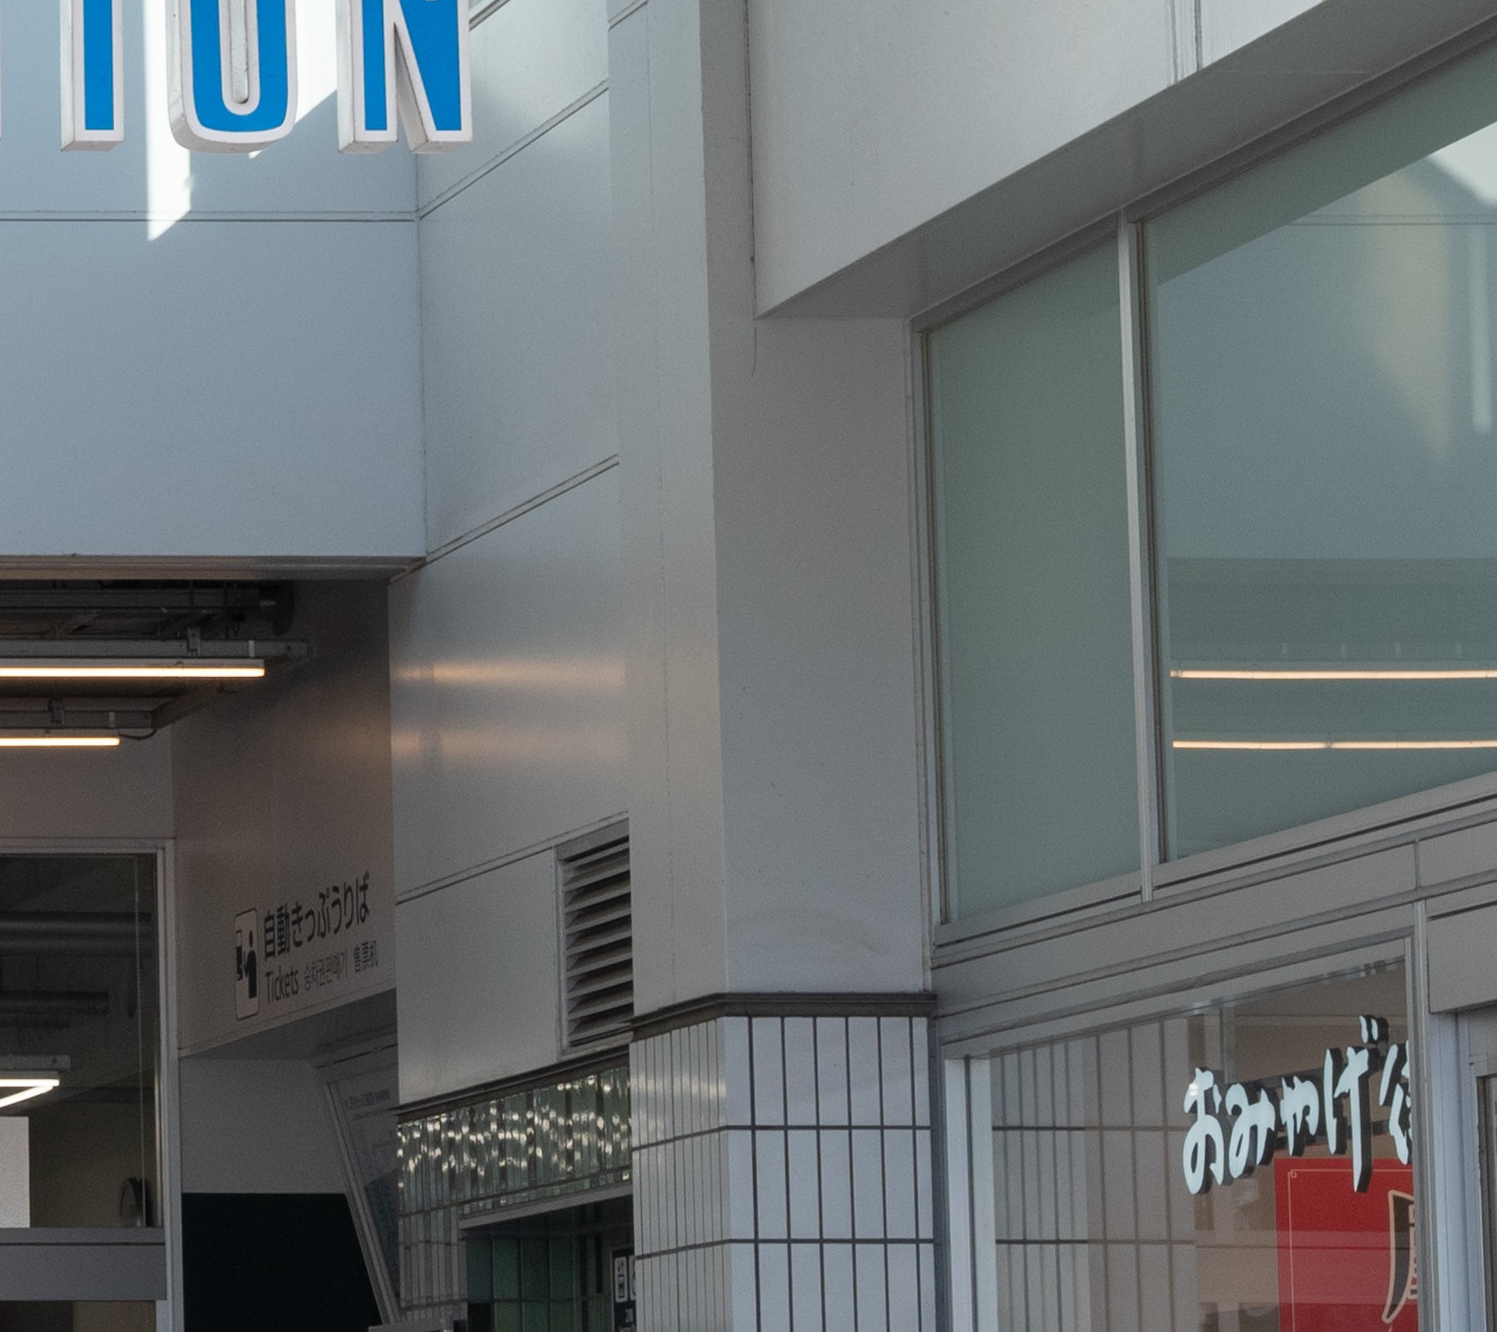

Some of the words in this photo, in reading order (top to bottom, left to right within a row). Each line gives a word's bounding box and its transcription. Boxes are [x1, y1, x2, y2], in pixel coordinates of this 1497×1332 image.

[263, 869, 371, 962] 自動きっぷうりば
[264, 964, 300, 1005] Tickets
